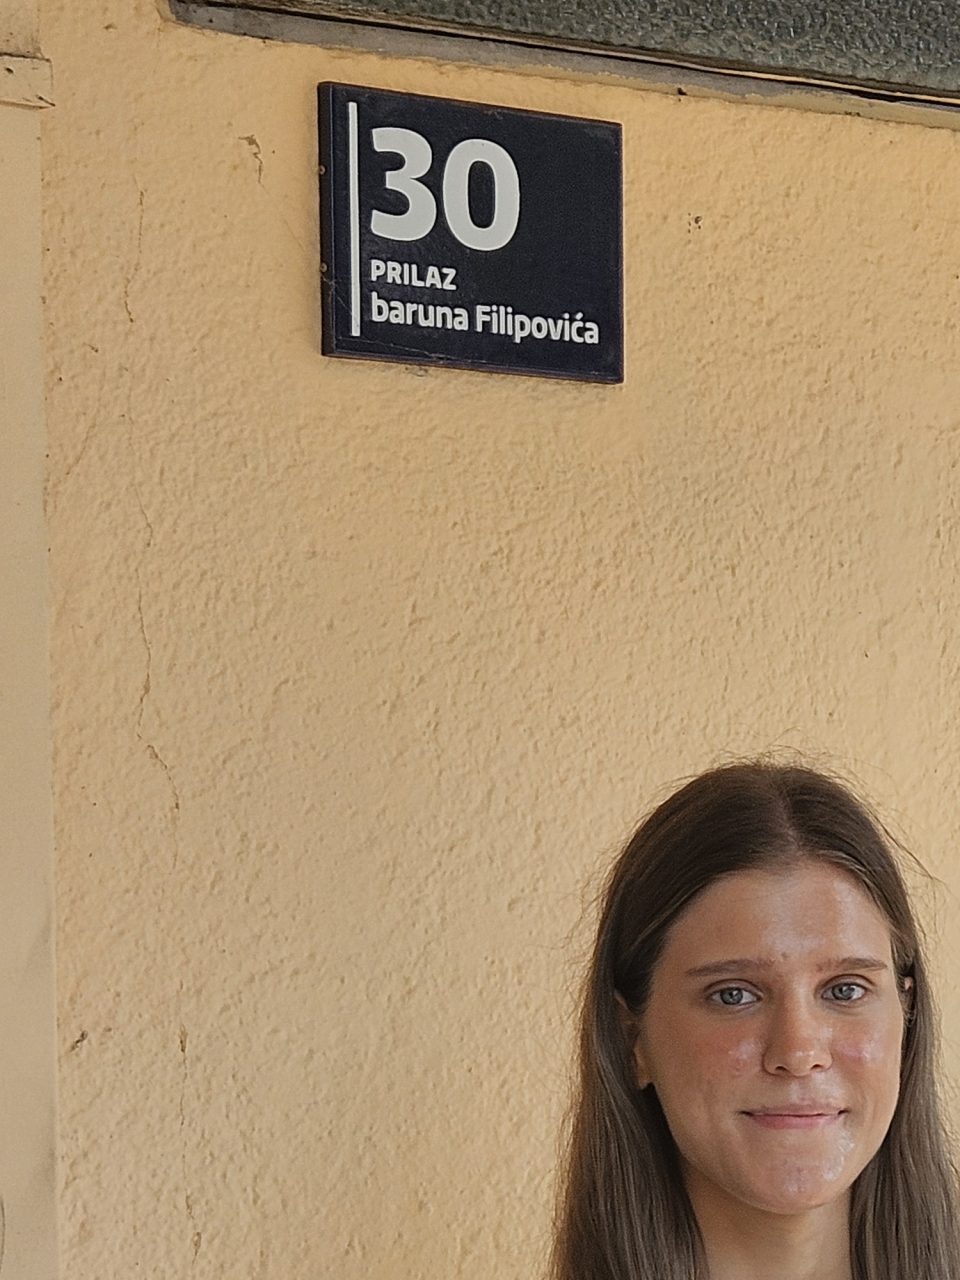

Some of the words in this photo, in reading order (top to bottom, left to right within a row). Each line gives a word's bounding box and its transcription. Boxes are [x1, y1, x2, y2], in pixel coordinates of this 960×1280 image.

[371, 126, 520, 251] 30
[370, 259, 457, 291] PRILAZ
[370, 291, 469, 331] baruna
[475, 304, 600, 344] Filipovića
